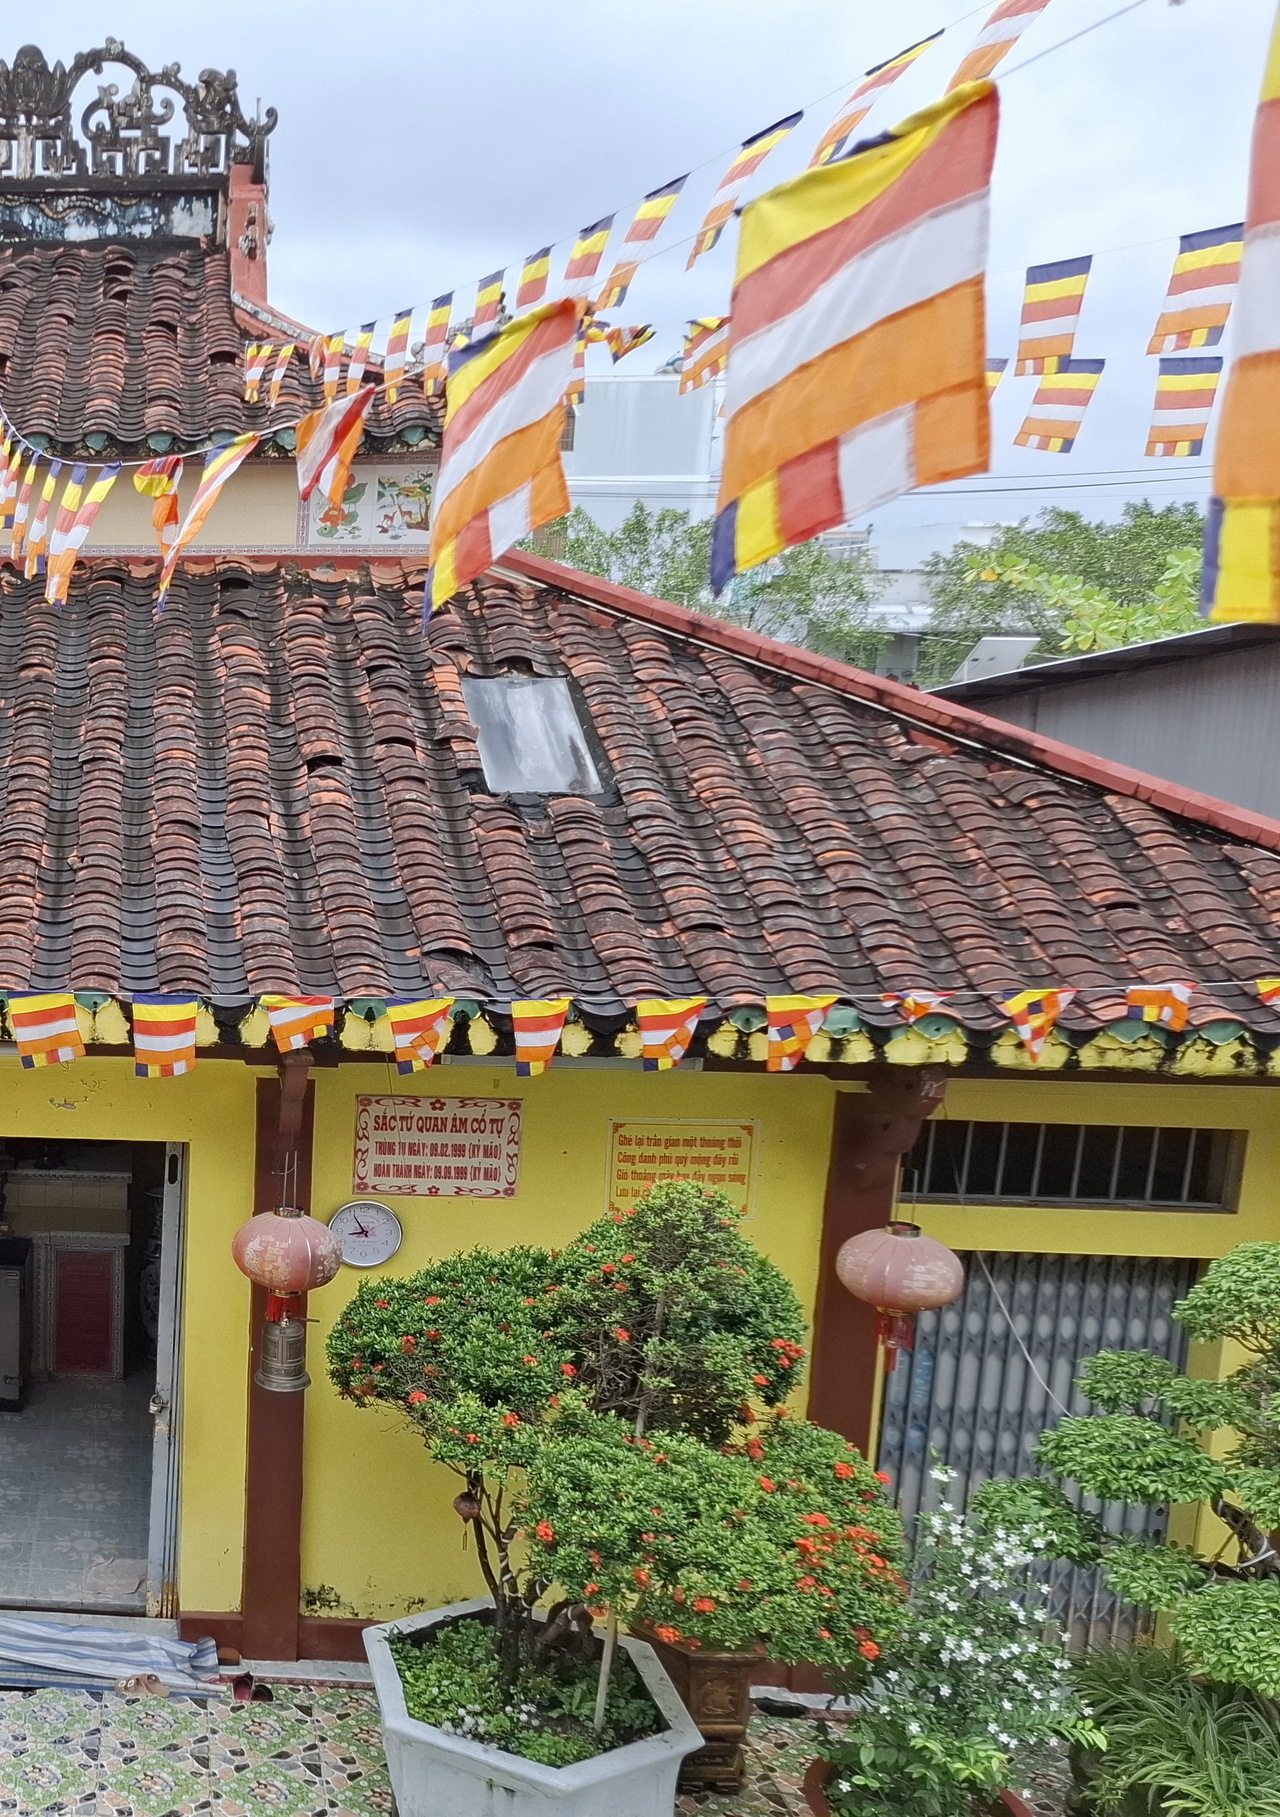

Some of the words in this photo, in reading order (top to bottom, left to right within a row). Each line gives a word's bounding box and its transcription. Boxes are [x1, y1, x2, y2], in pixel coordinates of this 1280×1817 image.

[373, 1107, 397, 1132] SẮC
[398, 1110, 415, 1132] TỨ
[416, 1115, 448, 1134] QUAN
[450, 1112, 468, 1133] ÂM
[470, 1109, 487, 1134] CỔ
[489, 1116, 506, 1139] TỰ
[375, 1137, 397, 1156] TRÙNG
[397, 1141, 407, 1156] TU
[407, 1138, 428, 1157] NGÀY:
[429, 1142, 466, 1158] 09.02.1999
[617, 1151, 636, 1167] Công
[638, 1152, 657, 1164] danh
[373, 1160, 391, 1178] HOÀN
[392, 1160, 413, 1179] THÀNH
[413, 1161, 433, 1179] NGÀY:
[339, 1216, 349, 1225] 10
[381, 1217, 390, 1225] 2
[384, 1228, 393, 1236] 3
[359, 1250, 368, 1258] 6
